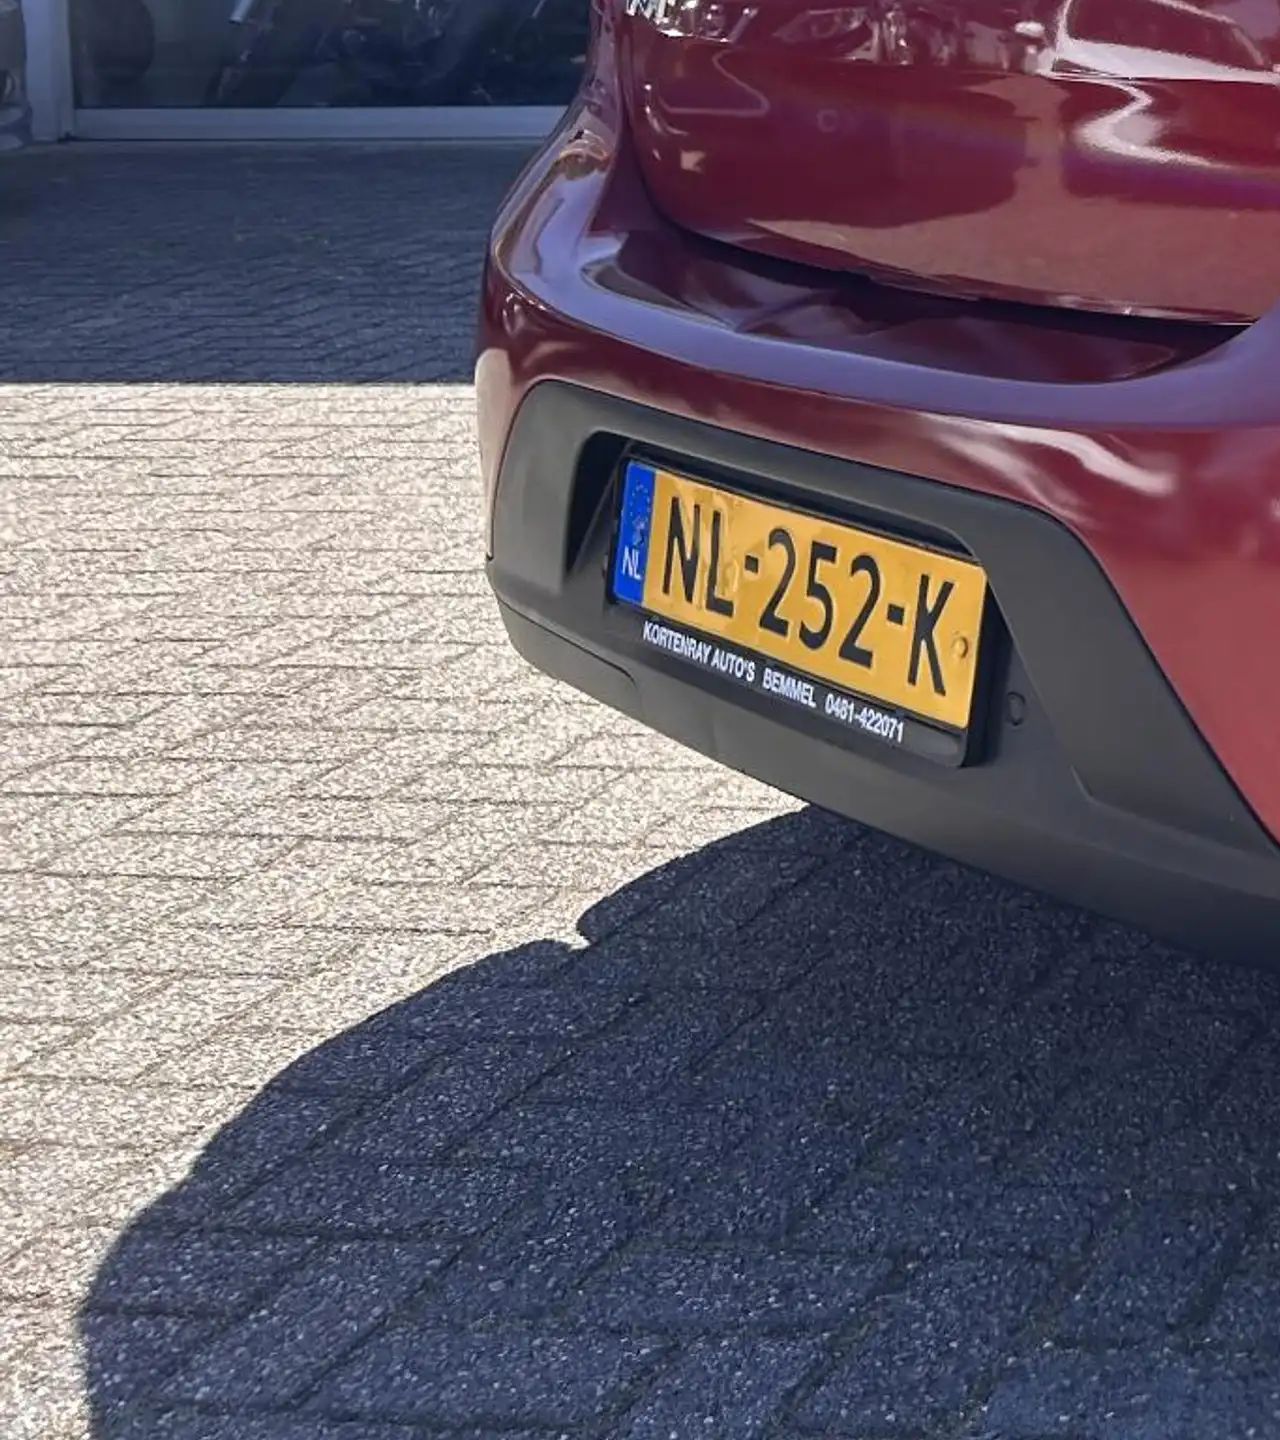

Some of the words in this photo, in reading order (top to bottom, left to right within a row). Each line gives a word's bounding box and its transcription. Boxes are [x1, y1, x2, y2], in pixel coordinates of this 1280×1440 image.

[621, 545, 643, 581] NL
[662, 496, 955, 697] NL-252-K
[643, 620, 712, 664] KORTENRAY
[710, 648, 756, 682] AUTO'S
[762, 667, 817, 709] BEMMEL
